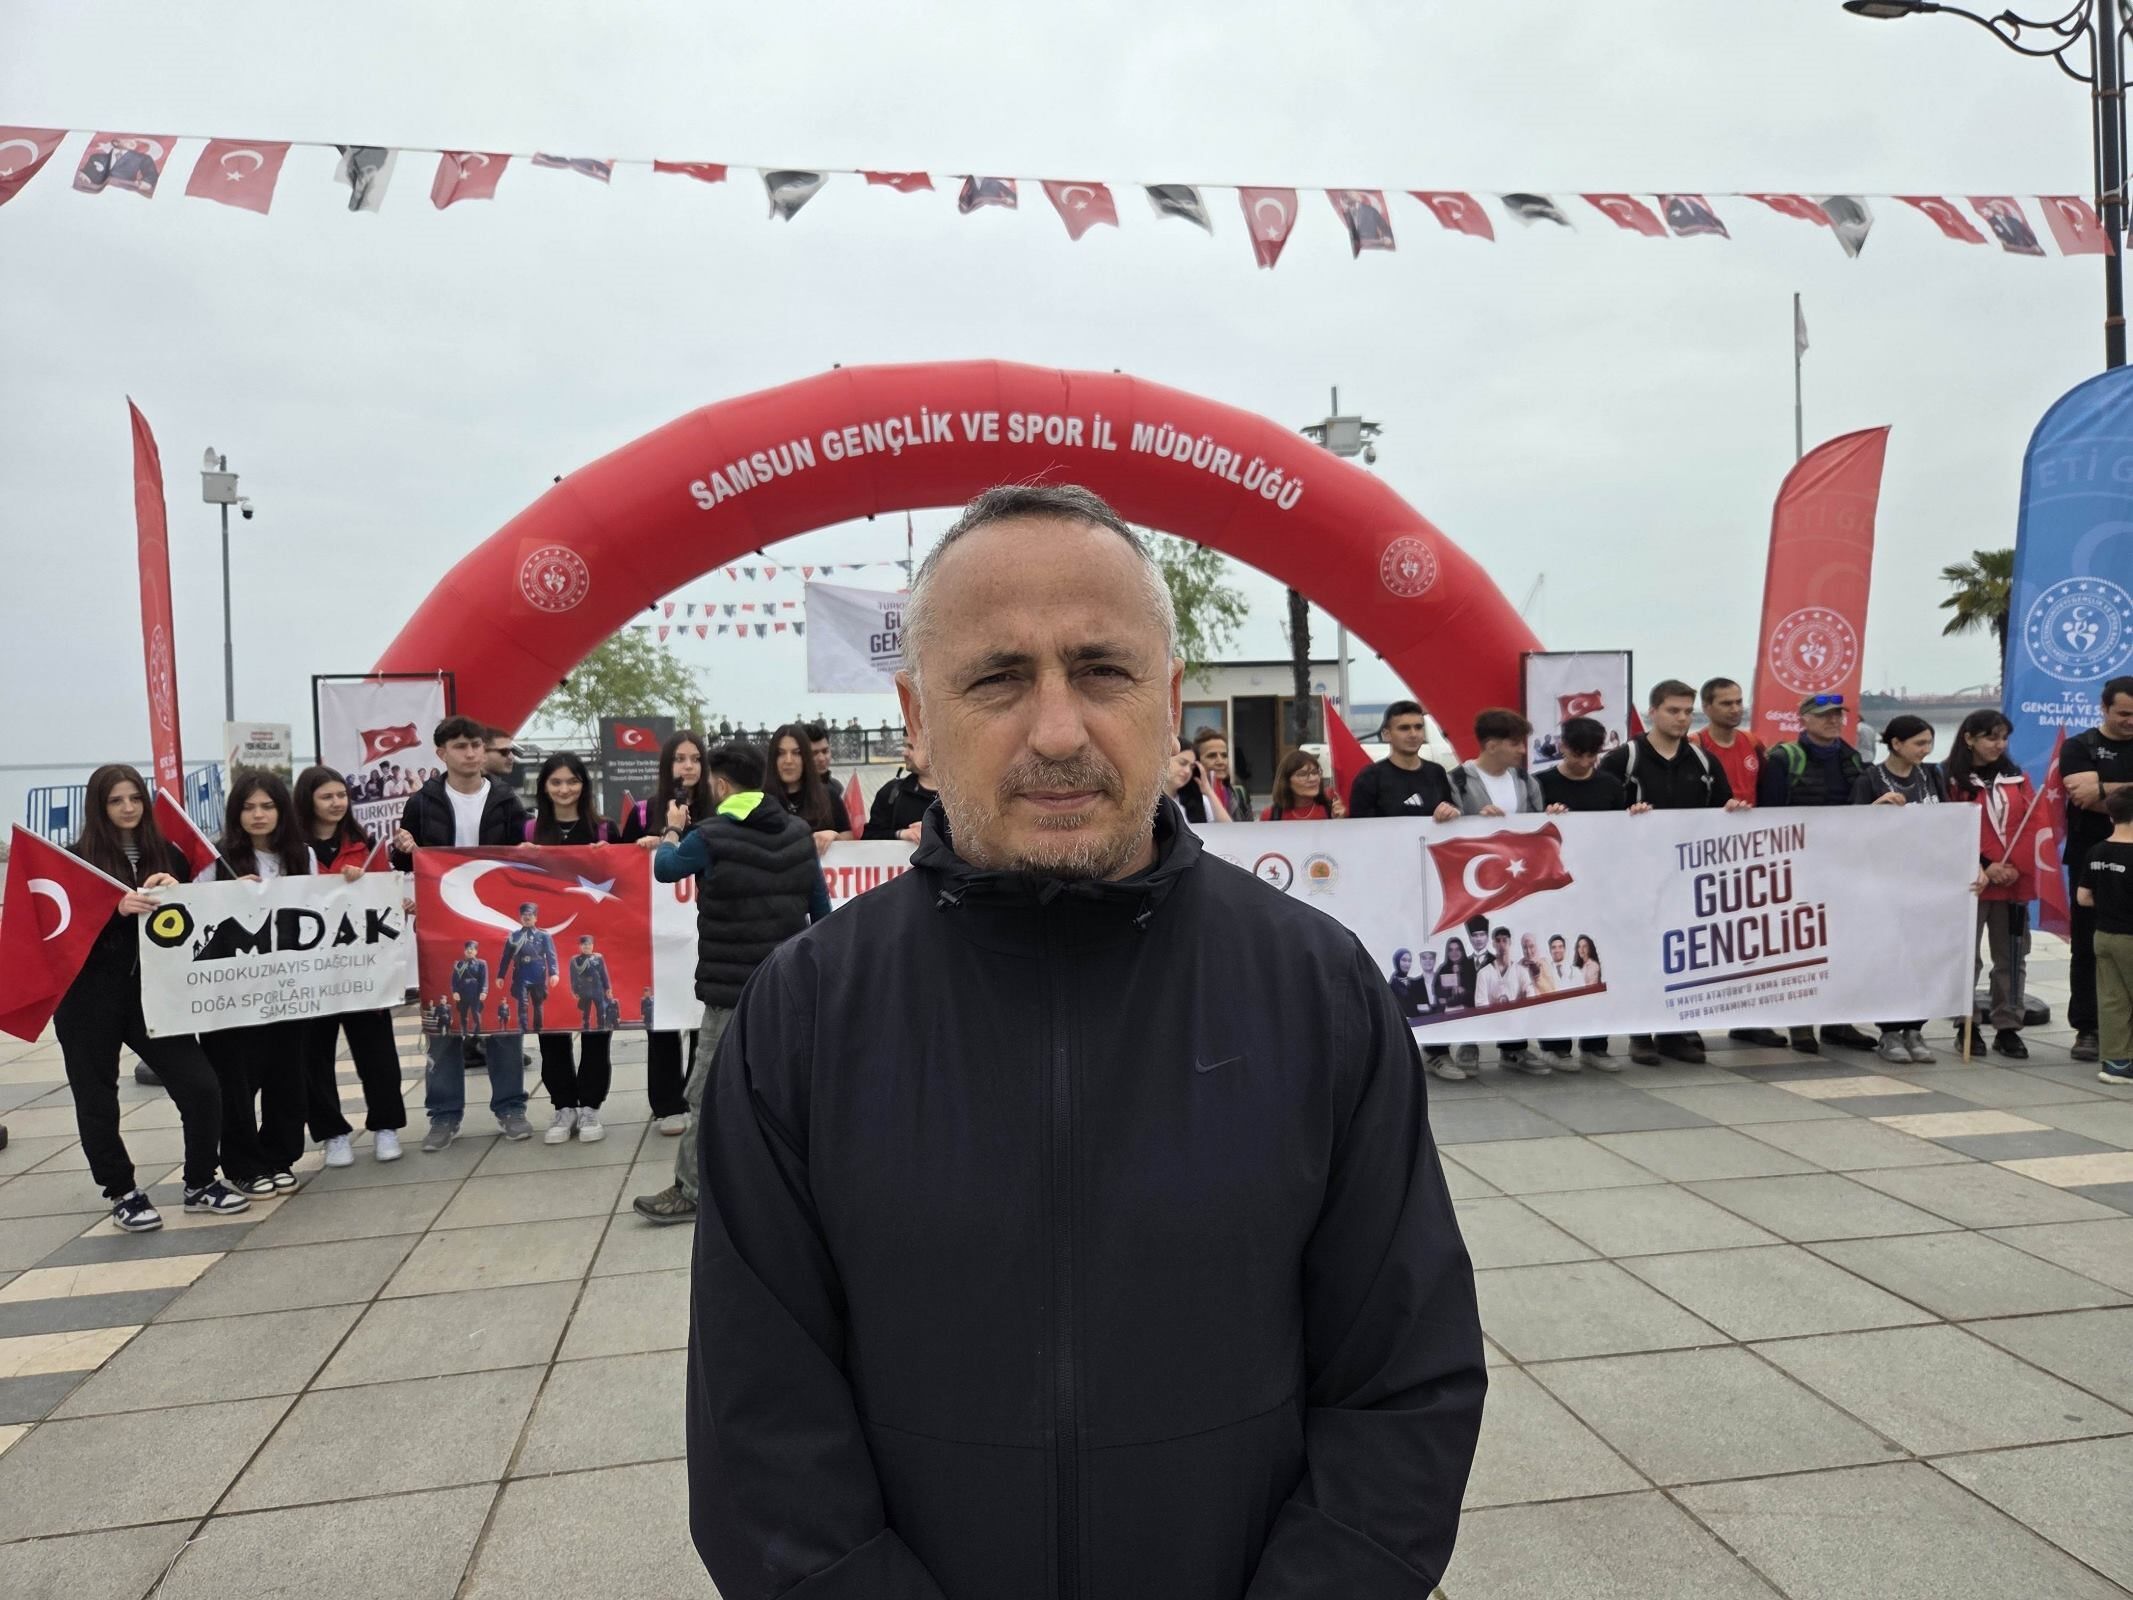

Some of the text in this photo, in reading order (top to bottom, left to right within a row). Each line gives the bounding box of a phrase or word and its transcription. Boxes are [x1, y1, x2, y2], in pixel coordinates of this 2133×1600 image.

[690, 406, 1304, 511] SAMSUN GENÇLİK VE SPOR İL MÜDÜRLÜĞÜ
[2061, 691, 2089, 703] T.C.
[2076, 704, 2093, 715] VE
[1675, 823, 1805, 871] TÜRKİYE'NİN
[1694, 859, 1793, 918] GÜCÜ
[145, 902, 401, 962] OMDAK
[1663, 901, 1827, 975] GENÇLİĞİ
[191, 995, 237, 1013] DOĞA
[241, 986, 315, 1007] SPORLARI
[277, 977, 297, 988] ve
[260, 1000, 321, 1018] SAMSUN
